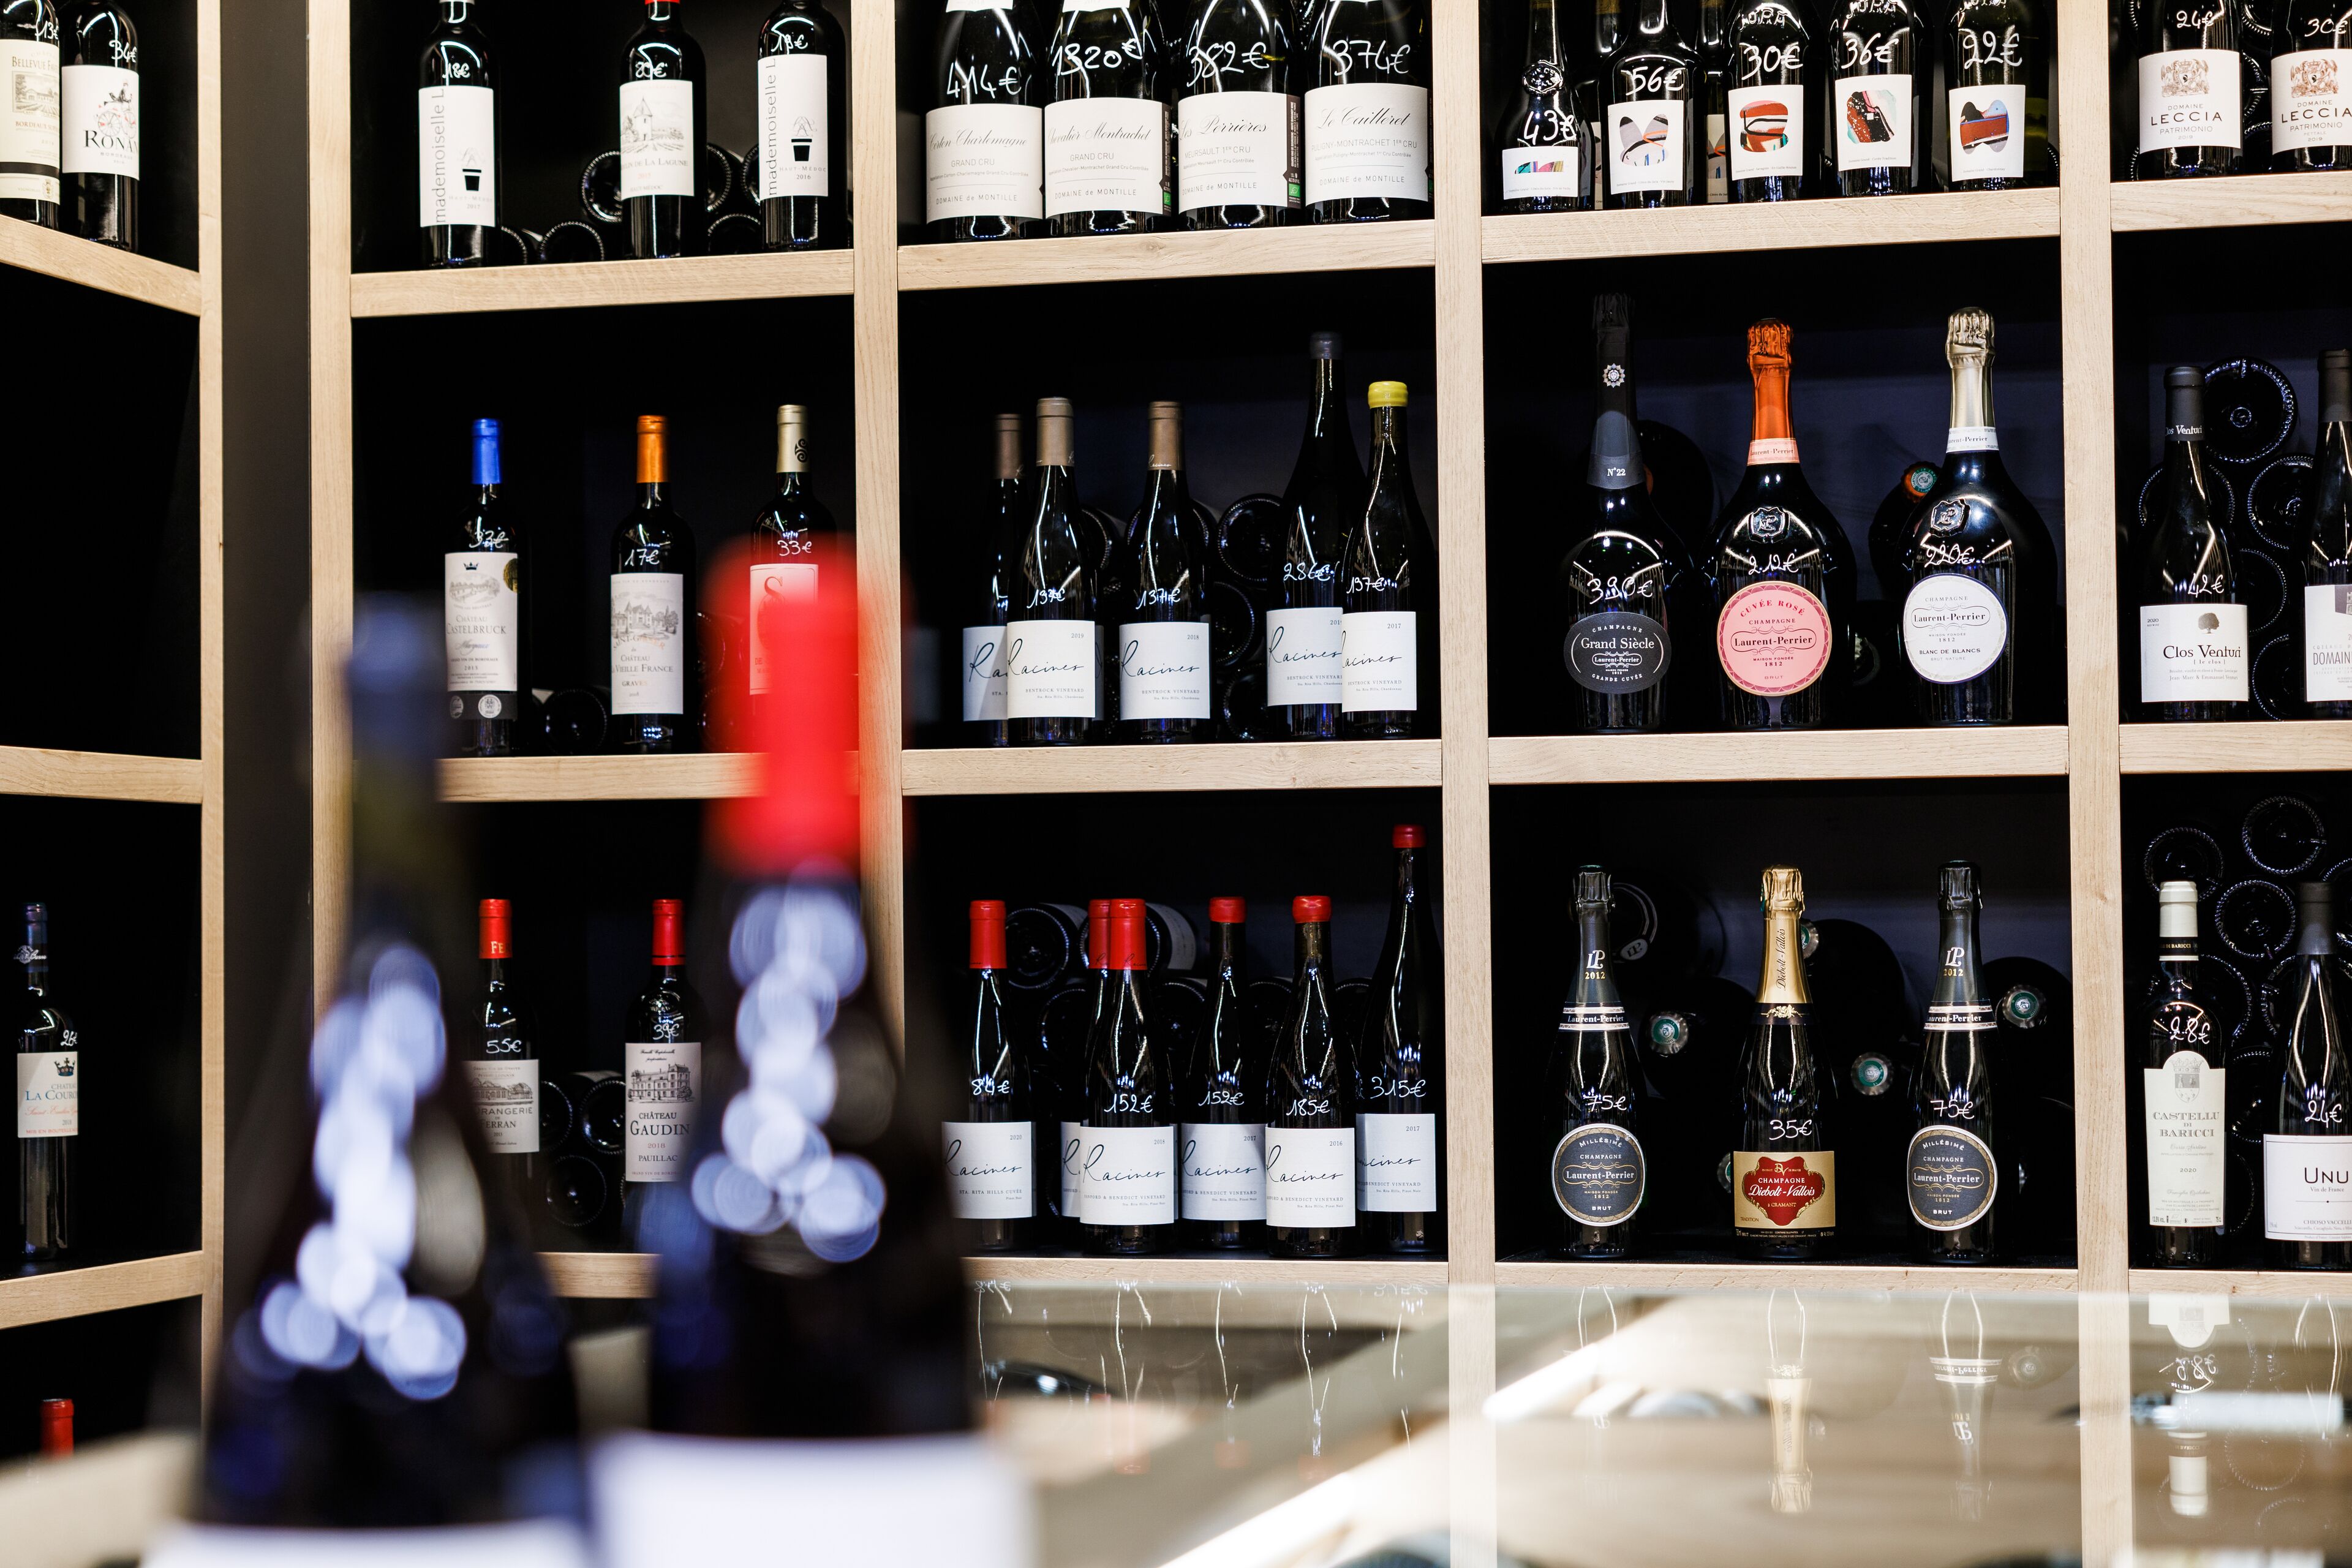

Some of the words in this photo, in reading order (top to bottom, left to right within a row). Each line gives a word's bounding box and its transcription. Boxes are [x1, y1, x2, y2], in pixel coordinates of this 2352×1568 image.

[2176, 10, 2214, 29] 24€
[2305, 18, 2348, 37] 30€
[1331, 40, 1411, 76] 374€
[1841, 33, 1899, 69] 36€
[12, 56, 47, 70] BELLEVUE
[1186, 42, 1270, 87] 382€
[1741, 45, 1803, 81] 30€
[946, 62, 1021, 99] 414€
[1626, 66, 1684, 96] 56€
[2151, 111, 2223, 126] LECCIA
[2282, 107, 2352, 123] LECCIA
[765, 74, 777, 195] mademoiselle
[1523, 110, 1577, 145] 43€
[2160, 125, 2213, 135] PATRIMONIO
[2290, 122, 2343, 132] PATRIMONIO
[1311, 138, 1390, 152] PULIGNY-MONTRACHET
[1403, 140, 1417, 149] CRU
[431, 104, 445, 223] mademoiselle
[658, 157, 688, 167] LAGUNE
[1069, 153, 1095, 162] GRAND
[1319, 176, 1349, 186] DOMAINE
[936, 195, 963, 205] DOMAINE
[1055, 190, 1082, 200] DOMAINE
[1607, 467, 1626, 477] N°22
[778, 540, 812, 556] 33€
[625, 548, 660, 567] 17€
[1748, 553, 1798, 575] 212€
[2188, 573, 2224, 598] 42€
[1740, 599, 1773, 618] CUVÉE
[1778, 600, 1805, 616] ROSÉ
[1914, 612, 1986, 623] Laurent-Perrier
[1268, 626, 1341, 667] Racines
[1581, 638, 1616, 649] Grand
[1619, 637, 1654, 649] Siècle
[1735, 636, 1812, 647] Laurent-Perrier
[1008, 638, 1084, 676] Racines
[1120, 639, 1200, 680] Racines
[2163, 645, 2193, 658] Clos
[2198, 644, 2241, 658] Venturi
[641, 663, 673, 673] FRANCE
[1621, 673, 1643, 682] CUVÉE
[1586, 950, 1605, 969] LP
[1945, 947, 1965, 967] LP
[652, 1023, 679, 1040] 39€
[2170, 1017, 2210, 1044] 28€
[486, 1039, 521, 1054] 55€
[971, 1077, 1010, 1095] 84€
[1370, 1077, 1427, 1099] 315€
[1104, 1094, 1153, 1113] 152€
[1199, 1091, 1244, 1106] 152€
[1583, 1095, 1627, 1111] 75€
[639, 1110, 677, 1120] CHÂTEAU
[1286, 1099, 1330, 1116] 185€
[1930, 1099, 1974, 1119] 75€
[2305, 1100, 2342, 1128] 24€
[2152, 1112, 2220, 1121] CASTELLU
[630, 1120, 690, 1136] GAUDIN
[1769, 1119, 1812, 1140] 35€
[2160, 1129, 2215, 1138] BARICCI
[1579, 1137, 1623, 1148] MILLÉSIMÉ
[1923, 1139, 1964, 1150] MILLÉSIMÉ
[1083, 1144, 1166, 1183] Racines
[1266, 1145, 1344, 1183] Racines
[1566, 1170, 1634, 1180] Laurent-Perrier
[1914, 1172, 1980, 1183] Laurent-Perrier
[2304, 1167, 2349, 1184] UNU
